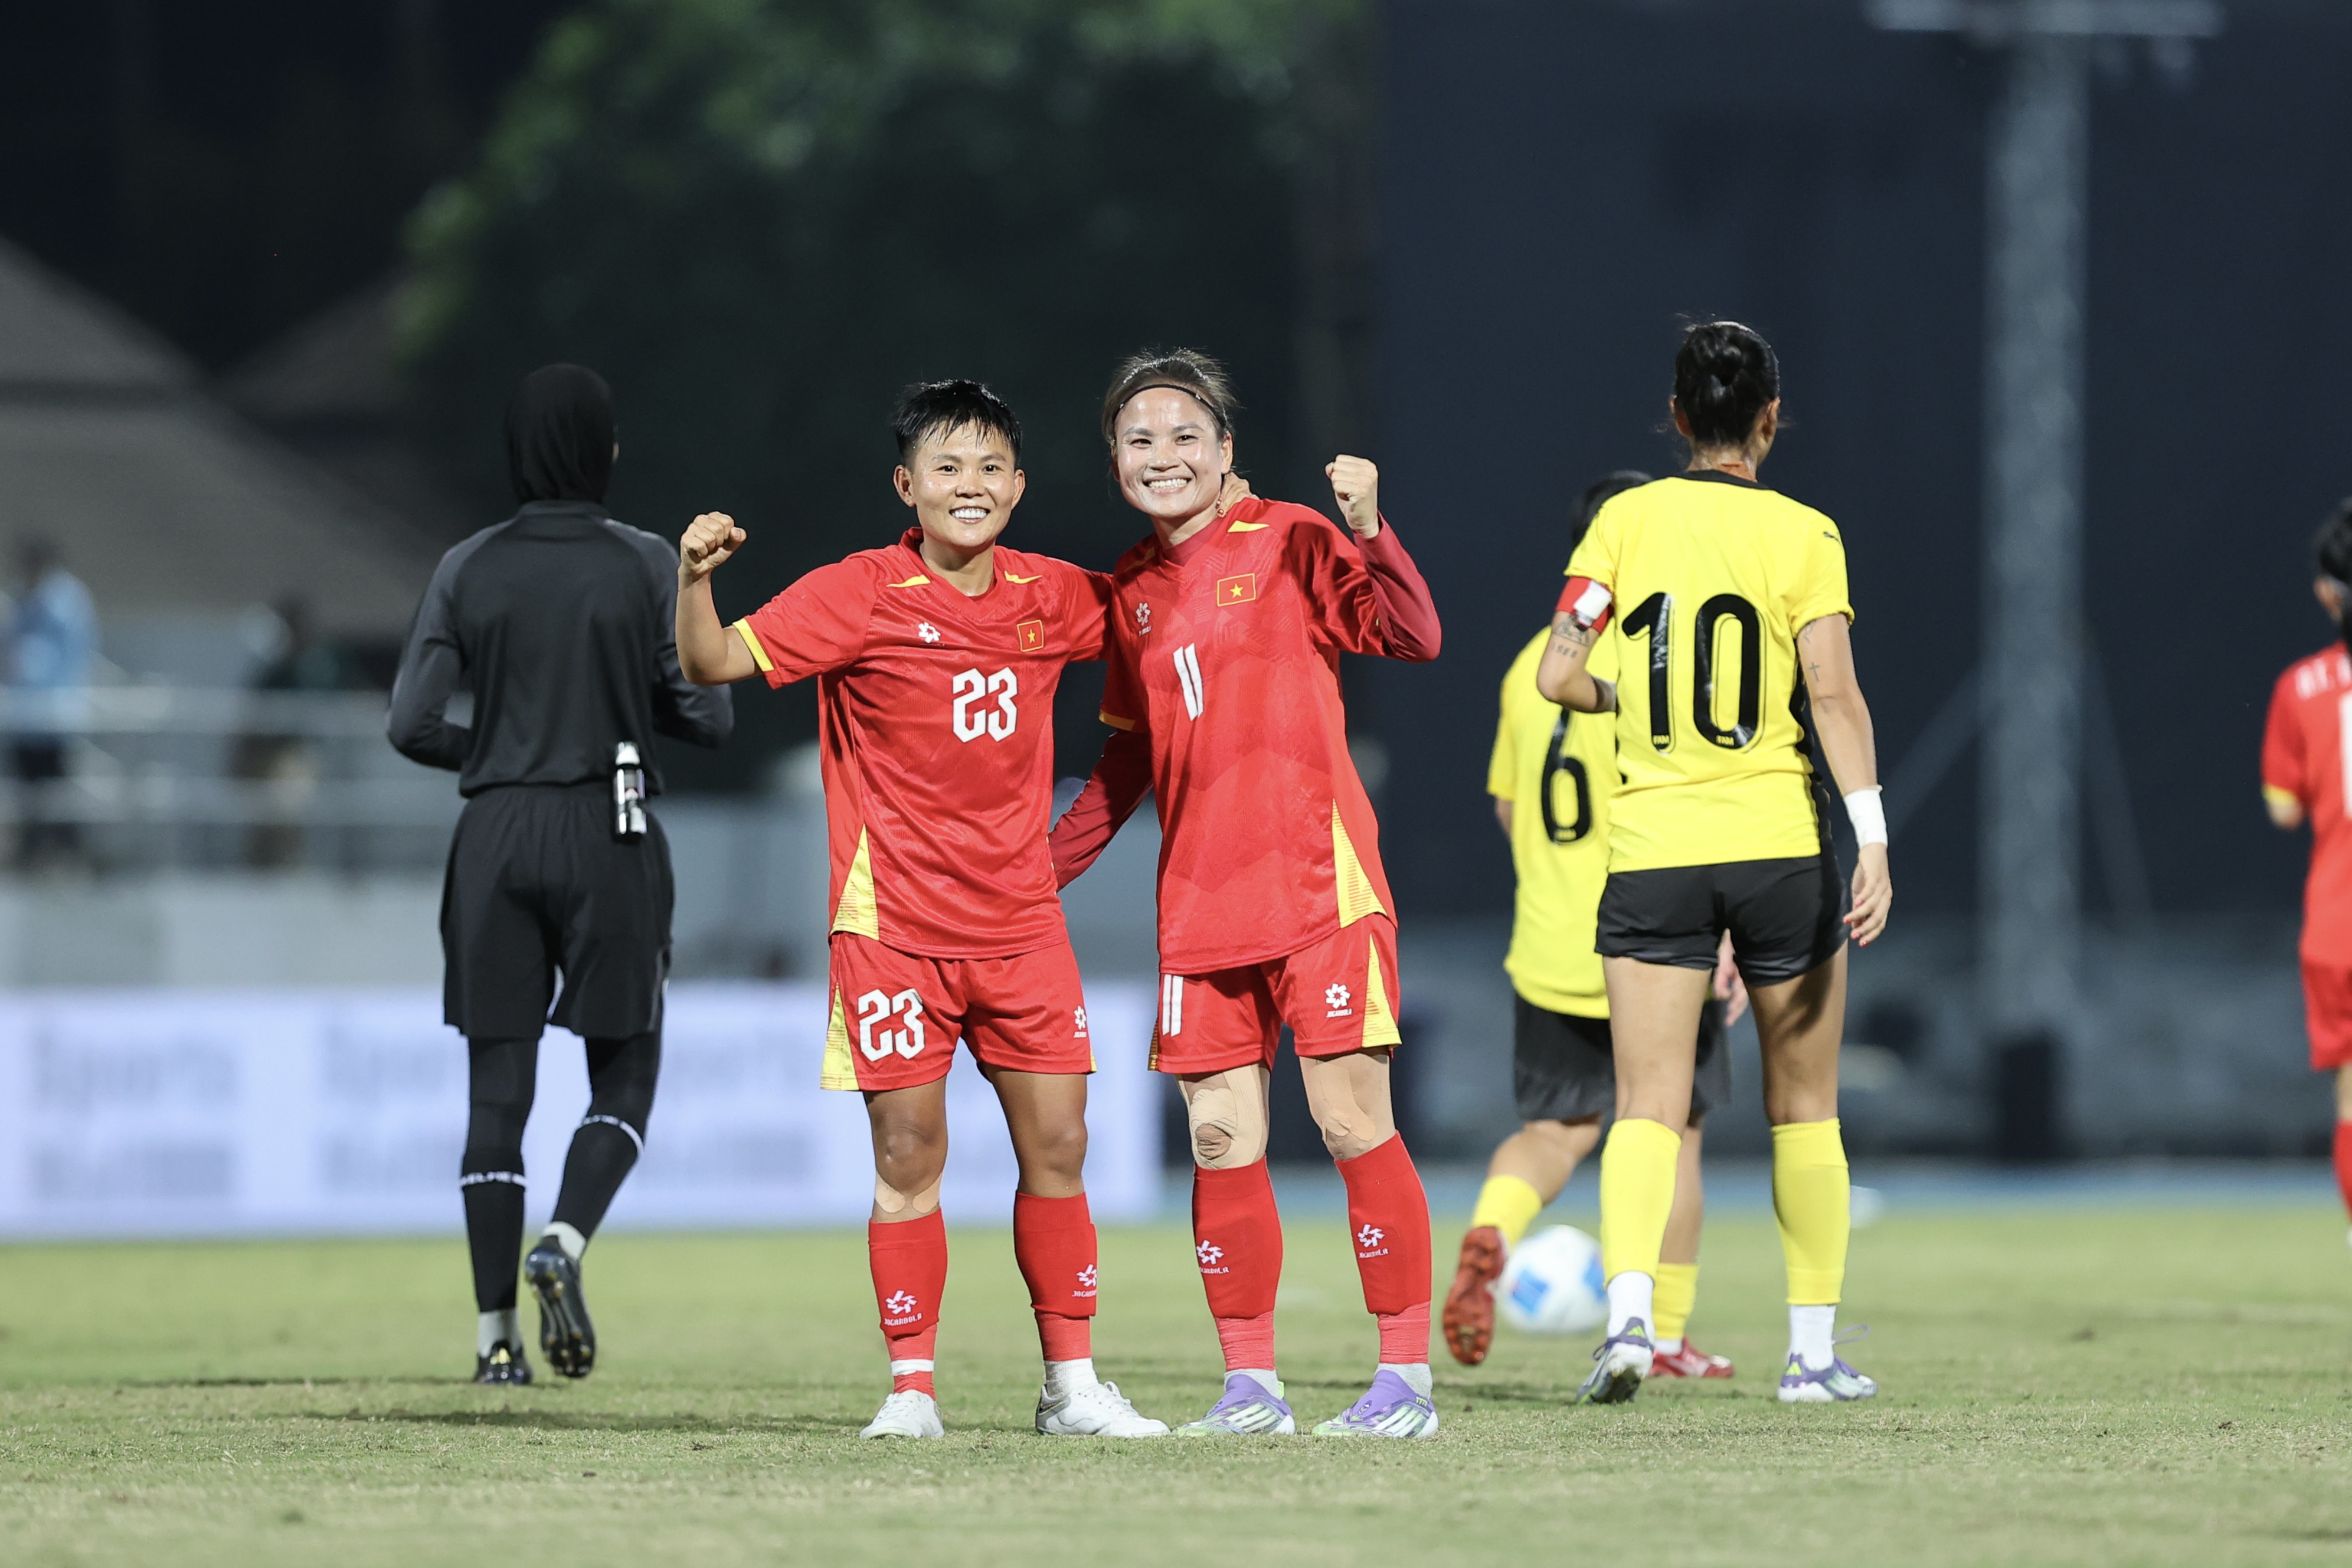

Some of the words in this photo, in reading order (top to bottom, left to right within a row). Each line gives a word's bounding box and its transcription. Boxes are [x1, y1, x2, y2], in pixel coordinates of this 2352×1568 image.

[952, 667, 1018, 743] 23
[1173, 642, 1203, 721] 11
[1621, 592, 1762, 751] 10
[1541, 706, 1591, 843] 6
[858, 988, 925, 1062] 23
[1162, 974, 1183, 1037] 11
